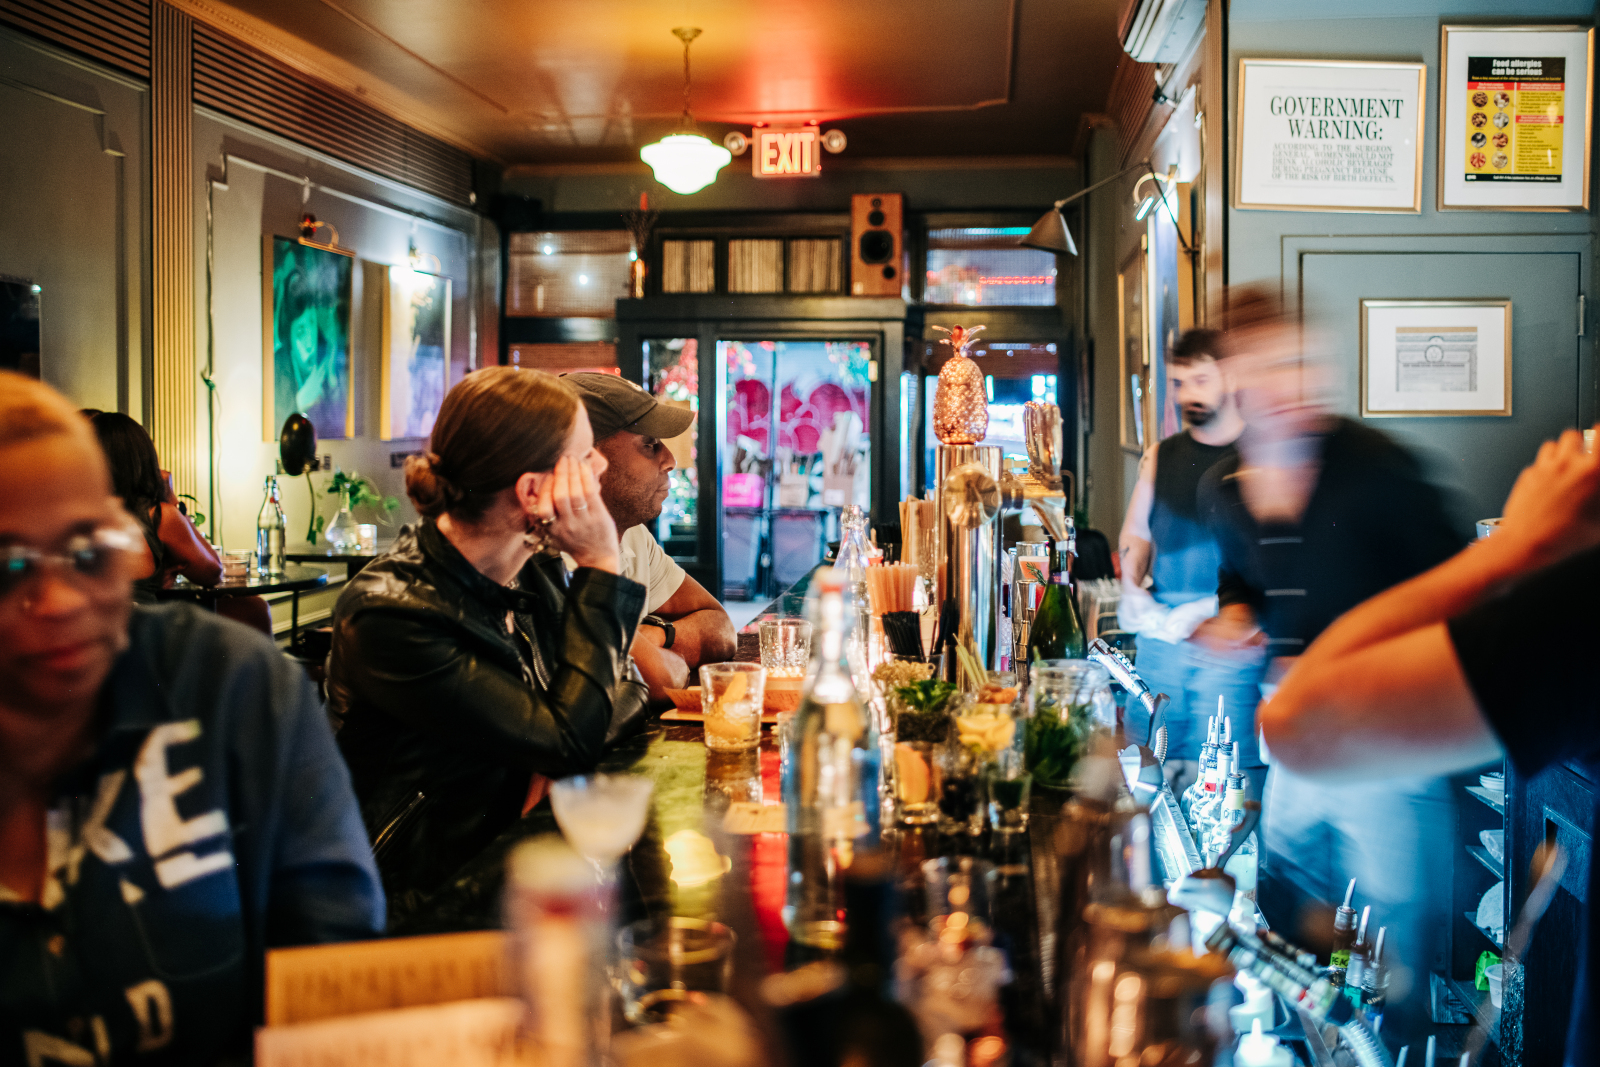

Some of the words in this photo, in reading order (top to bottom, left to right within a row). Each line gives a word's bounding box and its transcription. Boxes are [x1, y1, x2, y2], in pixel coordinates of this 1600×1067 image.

[1492, 58, 1510, 67] Food
[1510, 58, 1542, 69] allergies
[1505, 67, 1516, 75] be
[1516, 67, 1543, 75] serious
[1270, 95, 1404, 119] GOVERNMENT
[1288, 118, 1383, 141] WARNING:
[761, 132, 815, 175] EXIT
